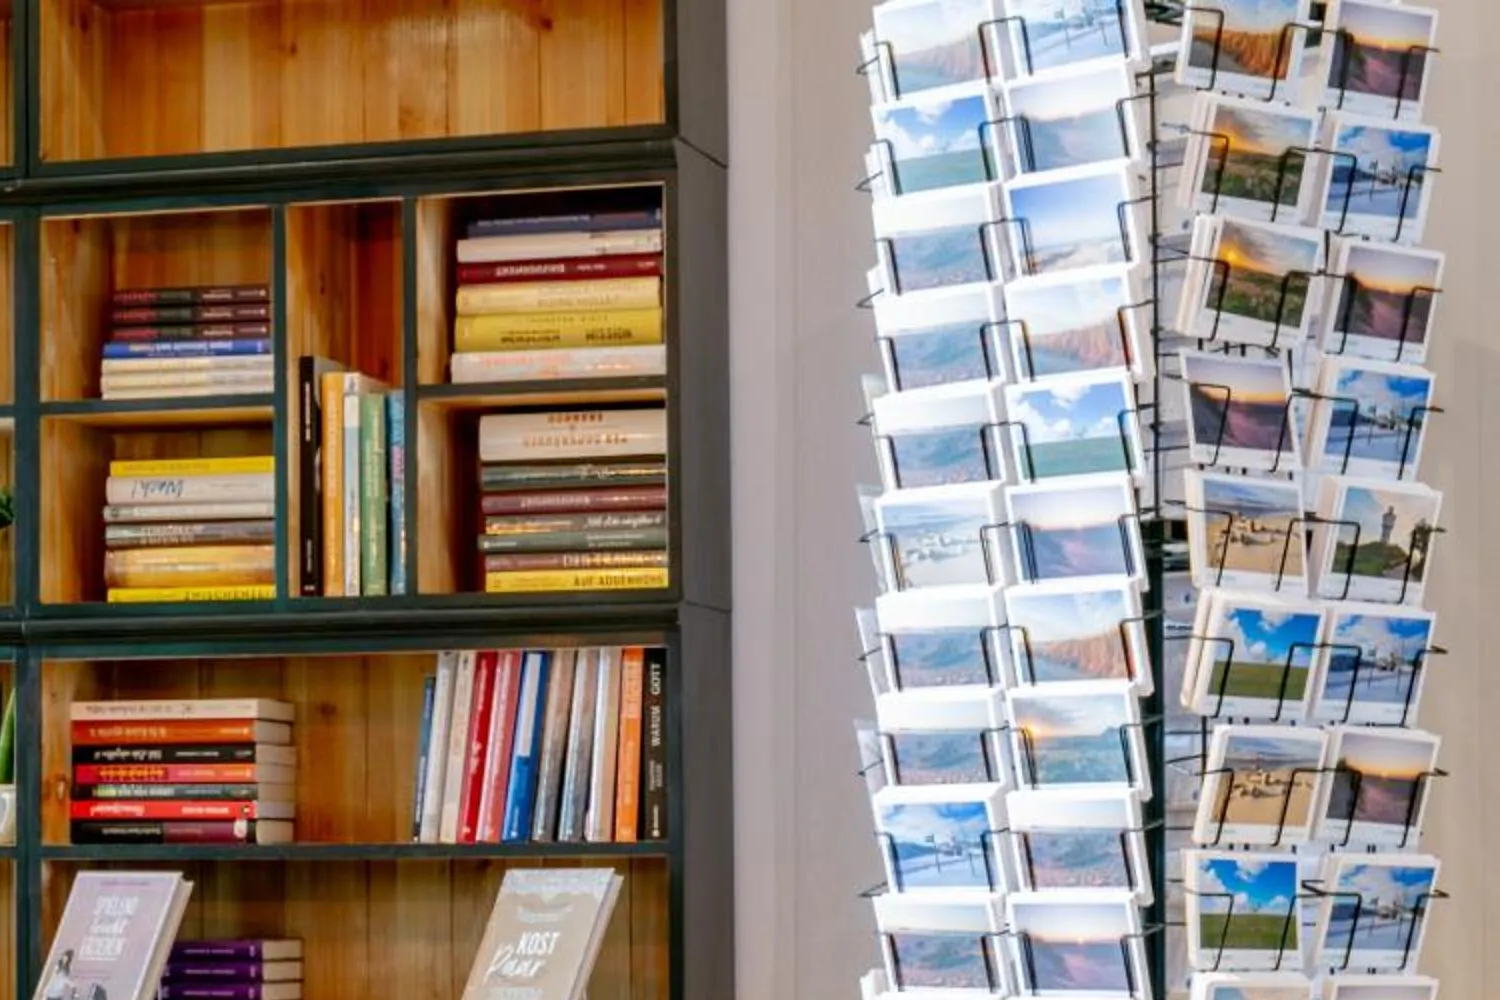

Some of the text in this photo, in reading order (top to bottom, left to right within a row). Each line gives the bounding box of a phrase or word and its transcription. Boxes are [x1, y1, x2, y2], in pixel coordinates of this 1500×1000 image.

[650, 663, 661, 746] WARUM GOTT
[518, 932, 560, 955] KOST
